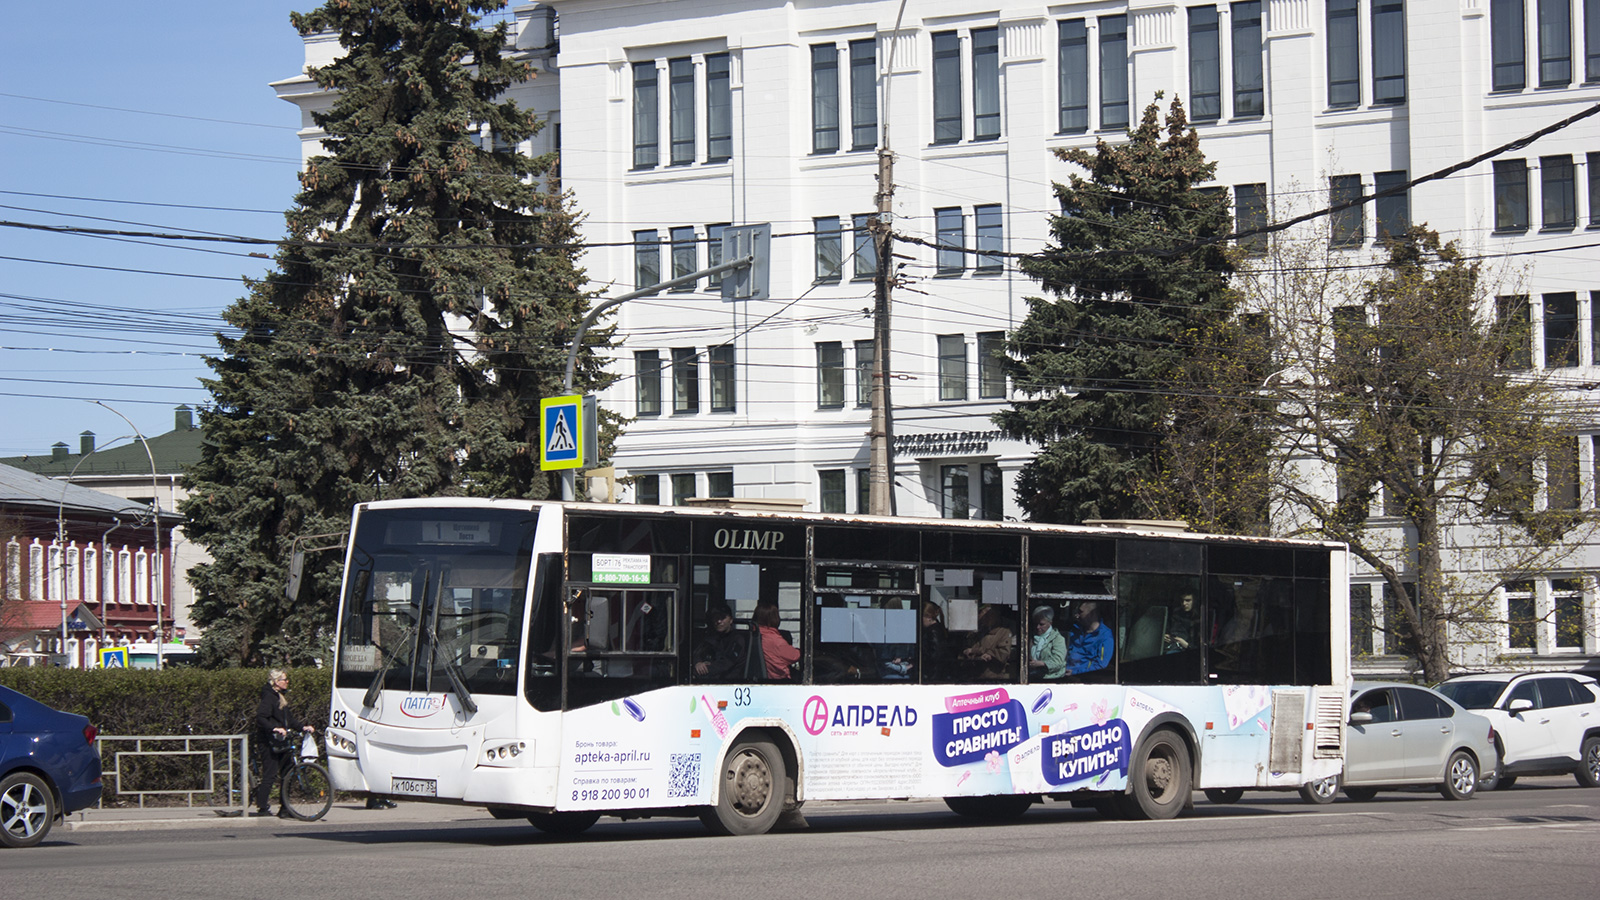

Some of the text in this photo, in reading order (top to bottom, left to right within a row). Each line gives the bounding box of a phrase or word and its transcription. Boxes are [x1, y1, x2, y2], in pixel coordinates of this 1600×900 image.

[893, 432, 957, 443] ОЛОГОДСКАЯ
[436, 522, 441, 539] 1
[714, 528, 784, 550] OLIMP
[598, 573, 649, 582] 8-800-700-16-36
[734, 687, 752, 706] 93
[952, 691, 1000, 708] Аптечный клуб
[332, 710, 347, 728] 93
[831, 704, 918, 728] АПРЕЛЬ
[952, 708, 1008, 735] ПРОСТО
[575, 740, 618, 749] Бронь товара:
[1052, 726, 1122, 758] ВЫГОДНО
[574, 749, 651, 766] apteka-april.ru
[573, 777, 600, 786] Справка
[610, 777, 637, 785] товарам:
[571, 787, 650, 801] 8 918 200 90 01
